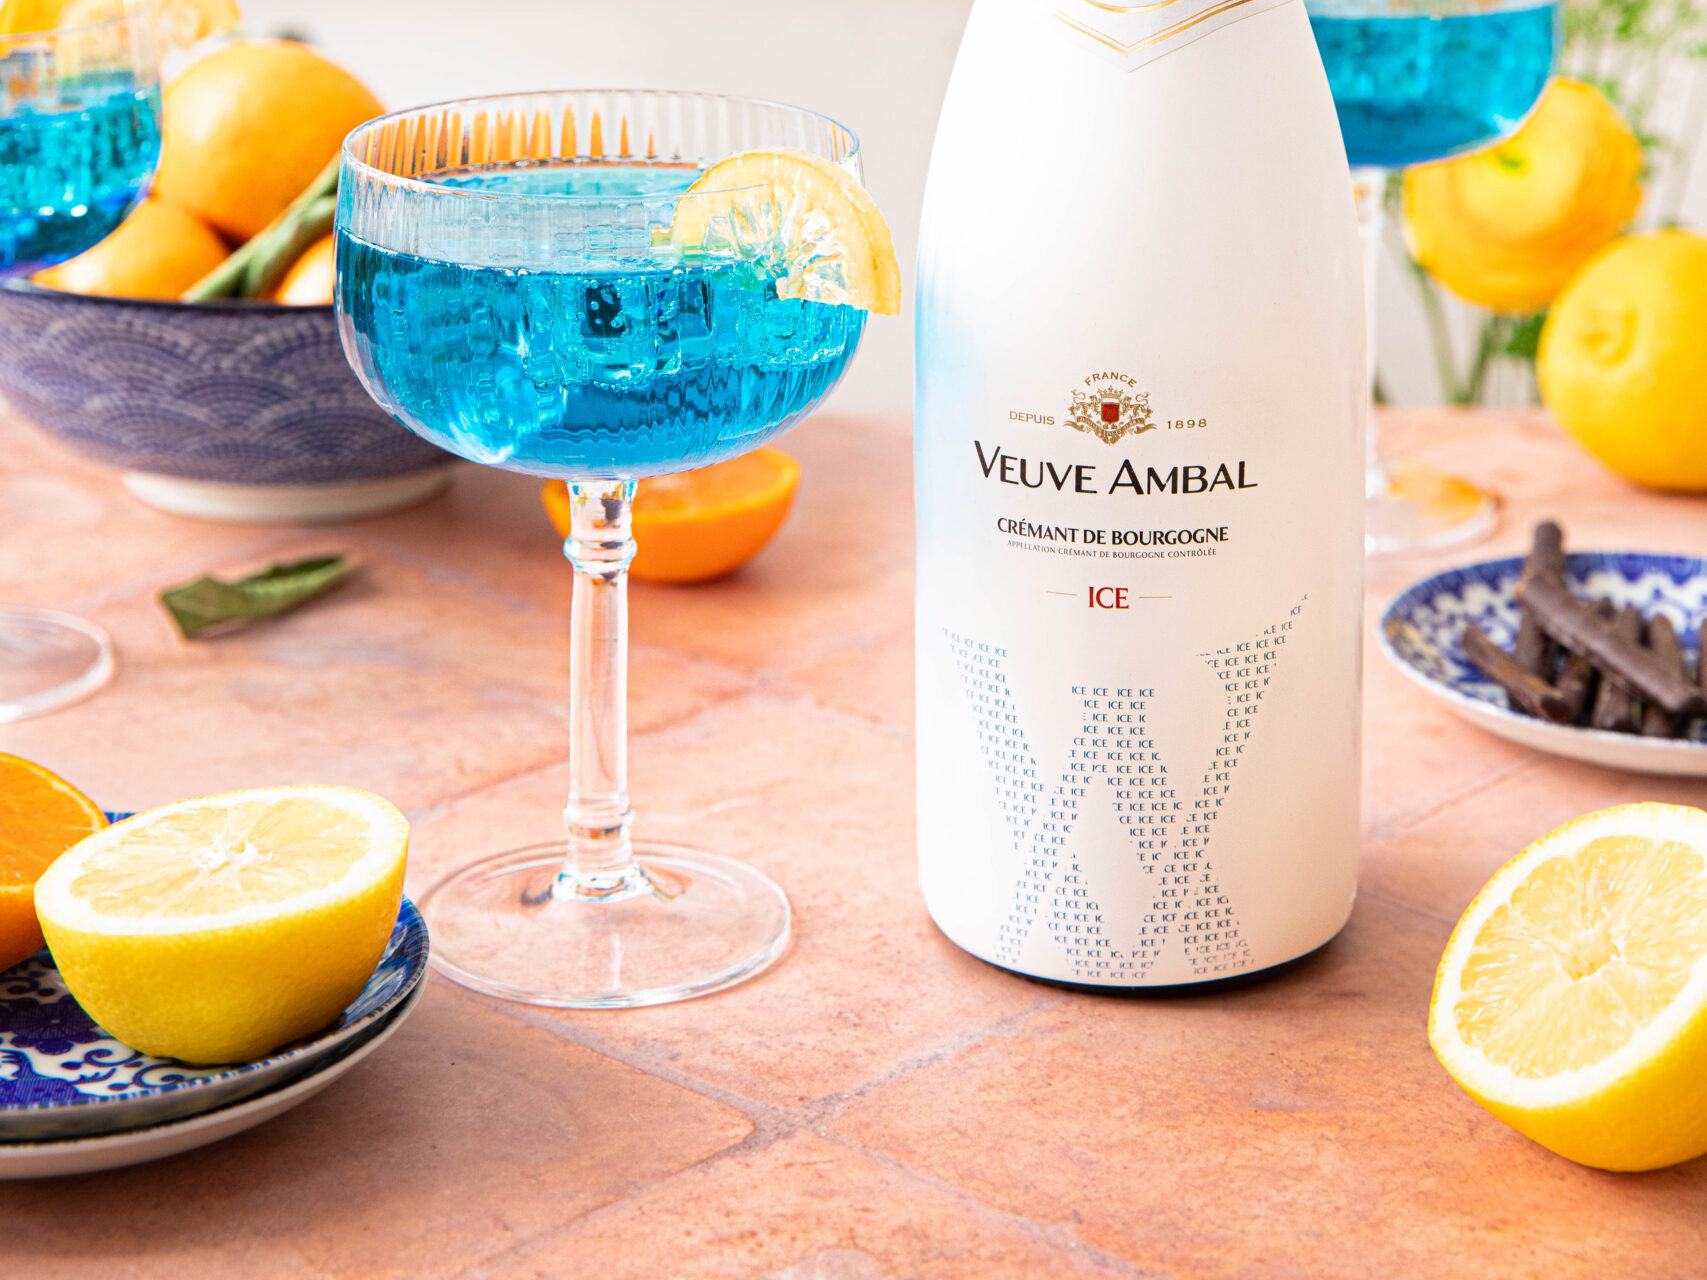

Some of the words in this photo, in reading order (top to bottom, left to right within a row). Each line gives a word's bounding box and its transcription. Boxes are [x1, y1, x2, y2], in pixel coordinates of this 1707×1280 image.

[1084, 371, 1137, 388] FRANCE
[1009, 411, 1055, 426] DEPUIS
[1166, 418, 1207, 430] 1898
[974, 440, 1097, 494] VEUVE
[1108, 458, 1258, 495] AMBAL
[997, 517, 1079, 543] CRÉMANT
[1083, 528, 1106, 545] DE
[1111, 526, 1229, 546] BOURGOGNE
[1007, 539, 1056, 554] APPELLATION
[1058, 547, 1097, 558] CRÉMANT
[1112, 551, 1165, 559] BOURGOGNE
[1167, 547, 1217, 558] CONTRÔLÉE
[1088, 586, 1129, 609] ICE
[1281, 621, 1292, 631] ICE
[1237, 642, 1250, 652] ICE
[1256, 639, 1269, 649] ICE
[1274, 635, 1286, 645] ICE
[1225, 657, 1239, 666] ICE
[1244, 654, 1258, 664] ICE
[1264, 650, 1276, 660] ICE
[1237, 668, 1250, 678] ICE
[1256, 664, 1269, 674] ICE
[1225, 683, 1239, 692] ICE
[1245, 680, 1258, 689] ICE
[1072, 686, 1086, 695] ICE
[1093, 688, 1108, 696] ICE
[1118, 688, 1132, 697] ICE
[1140, 688, 1154, 697] ICE
[1237, 693, 1250, 703] ICE
[1084, 700, 1099, 708] ICE
[1108, 701, 1123, 709] ICE
[1130, 702, 1145, 710] ICE
[1245, 705, 1258, 714] ICE
[1093, 713, 1107, 722] ICE
[1117, 714, 1132, 722] ICE
[1236, 718, 1250, 728] ICE
[1084, 725, 1098, 734] ICE
[1108, 726, 1122, 735] ICE
[1130, 727, 1145, 735] ICE
[1224, 733, 1238, 743] ICE
[1092, 739, 1107, 747] ICE
[1116, 740, 1132, 748] ICE
[1139, 740, 1153, 748] ICE
[1084, 750, 1098, 759] ICE
[1108, 752, 1122, 760] ICE
[1130, 752, 1144, 760] ICE
[1216, 747, 1230, 756] ICE
[1224, 758, 1238, 768] ICE
[1071, 762, 1085, 771] ICE
[1116, 765, 1132, 774] ICE
[1138, 765, 1154, 773] ICE
[1062, 774, 1076, 783] ICE
[1216, 772, 1230, 781] ICE
[1108, 777, 1122, 786] ICE
[1130, 778, 1144, 786] ICE
[1152, 777, 1166, 786] ICE
[1071, 788, 1085, 796] ICE
[1117, 790, 1132, 799] ICE
[1138, 790, 1153, 799] ICE
[1160, 790, 1175, 798] ICE
[1204, 786, 1218, 796] ICE
[1063, 800, 1076, 808] ICE
[1130, 803, 1144, 811] ICE
[1152, 802, 1166, 811] ICE
[1195, 800, 1210, 808] ICE
[1051, 811, 1064, 820] ICE
[1138, 816, 1154, 824] ICE
[1160, 814, 1176, 823] ICE
[1204, 811, 1217, 820] ICE
[1043, 822, 1056, 831] ICE
[1195, 824, 1210, 834] ICE
[1130, 828, 1145, 836] ICE
[1152, 828, 1167, 836] ICE
[1052, 836, 1065, 845] ICE
[1139, 840, 1154, 849] ICE
[1182, 838, 1198, 847] ICE
[1044, 848, 1056, 856] ICE
[1174, 851, 1189, 860] ICE
[1032, 858, 1044, 867] ICE
[1183, 862, 1198, 872] ICE
[1064, 875, 1078, 884] ICE
[1174, 875, 1190, 884] ICE
[1074, 888, 1088, 897] ICE
[1162, 888, 1177, 897] ICE
[1204, 885, 1218, 894] ICE
[1066, 900, 1079, 908] ICE
[1153, 901, 1168, 910] ICE
[1196, 898, 1210, 907] ICE
[1054, 911, 1066, 920] ICE
[1074, 913, 1088, 922] ICE
[1205, 909, 1219, 918] ICE
[1066, 924, 1080, 933] ICE
[1087, 926, 1100, 934] ICE
[1196, 922, 1210, 931] ICE
[1217, 918, 1231, 928] ICE
[1054, 935, 1067, 943] ICE
[1074, 937, 1088, 946] ICE
[1096, 939, 1110, 947] ICE
[1141, 938, 1155, 946] ICE
[1184, 935, 1198, 944] ICE
[1204, 932, 1218, 942] ICE
